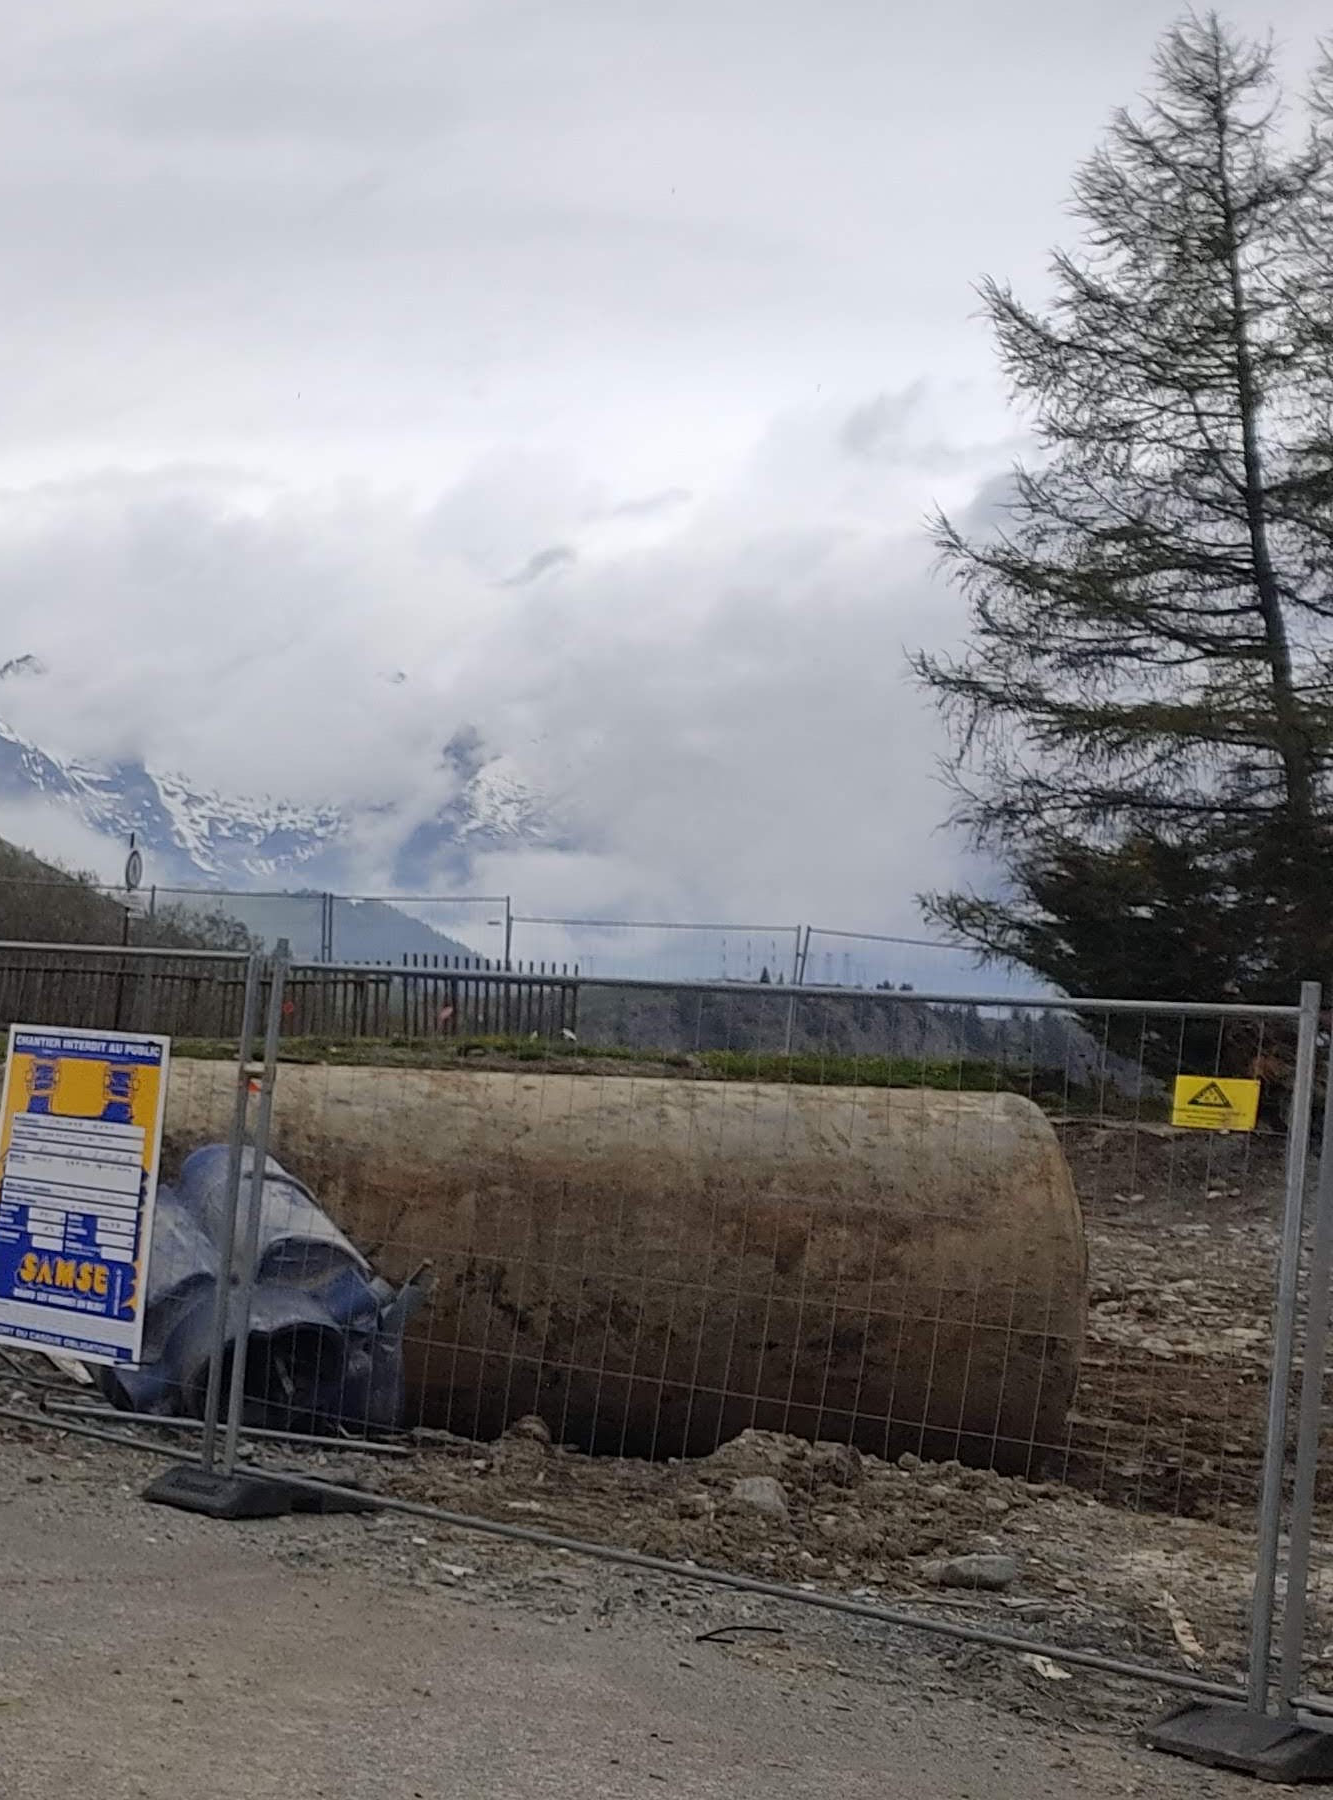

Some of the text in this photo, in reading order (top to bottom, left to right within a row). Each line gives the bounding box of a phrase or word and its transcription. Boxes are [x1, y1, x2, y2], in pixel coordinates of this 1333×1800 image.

[16, 1034, 62, 1050] CHANTIER
[63, 1039, 107, 1053] INTERDIT
[108, 1042, 124, 1055] AU
[124, 1043, 161, 1058] PUBLIC
[19, 1252, 109, 1295] SAMSE
